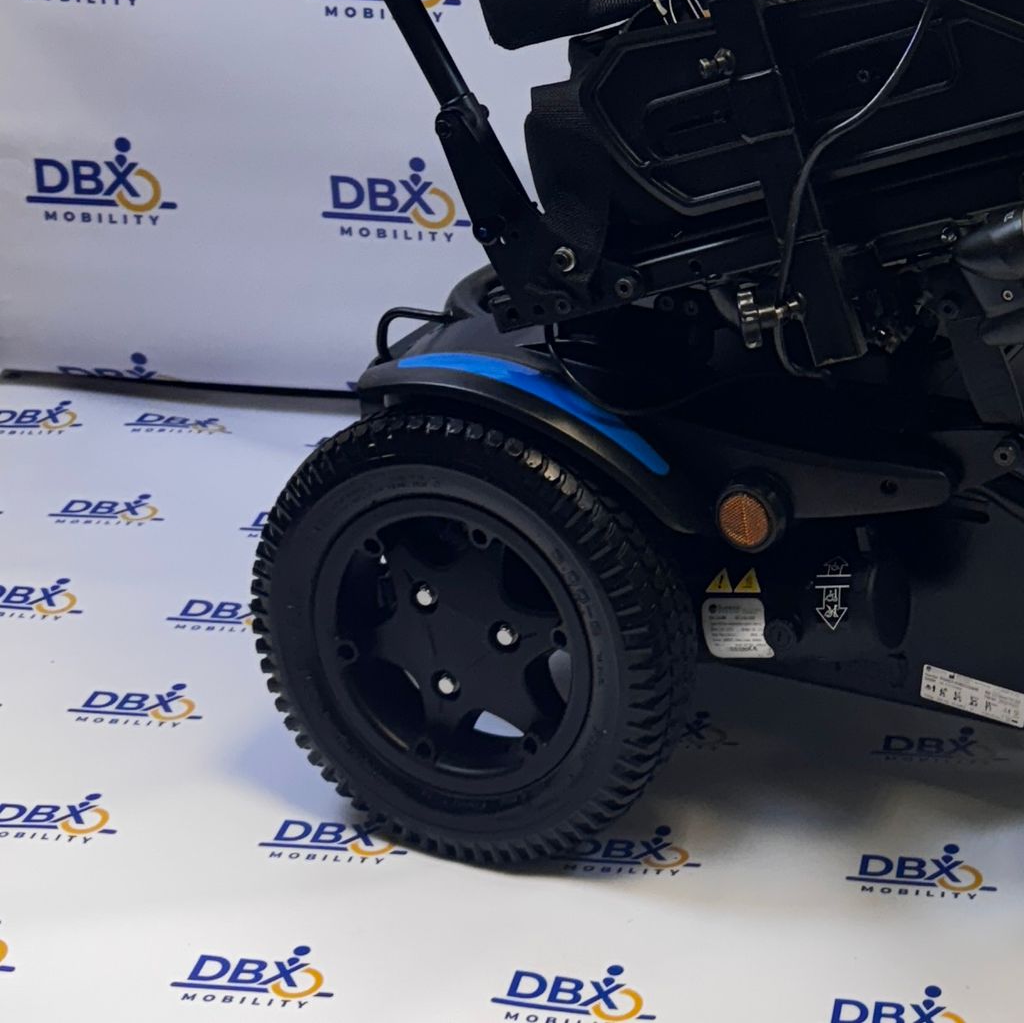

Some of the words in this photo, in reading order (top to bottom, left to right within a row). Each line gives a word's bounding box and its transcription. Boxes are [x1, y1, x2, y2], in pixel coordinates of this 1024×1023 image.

[325, 6, 442, 22] MOBIY
[34, 154, 140, 198] DBX
[330, 174, 435, 215] DBX
[44, 211, 159, 225] MOBILITY
[340, 226, 453, 242] MOBILITY
[61, 500, 148, 515] DBX
[0, 586, 67, 607] BX
[179, 599, 252, 619] DB
[174, 624, 247, 633] MOBILI
[82, 691, 184, 713] DBX
[75, 716, 180, 728] MOBILITY
[0, 803, 98, 825] DBX
[0, 832, 92, 844] OBILITY
[273, 819, 378, 847] DBX
[269, 851, 384, 864] MOBILITY
[563, 864, 680, 876] MOBILITY
[858, 854, 964, 883] DBX
[861, 885, 976, 900] MOBILITY
[187, 954, 310, 988] DBX
[506, 970, 626, 1010] DBX
[181, 993, 308, 1008] MOBILITY
